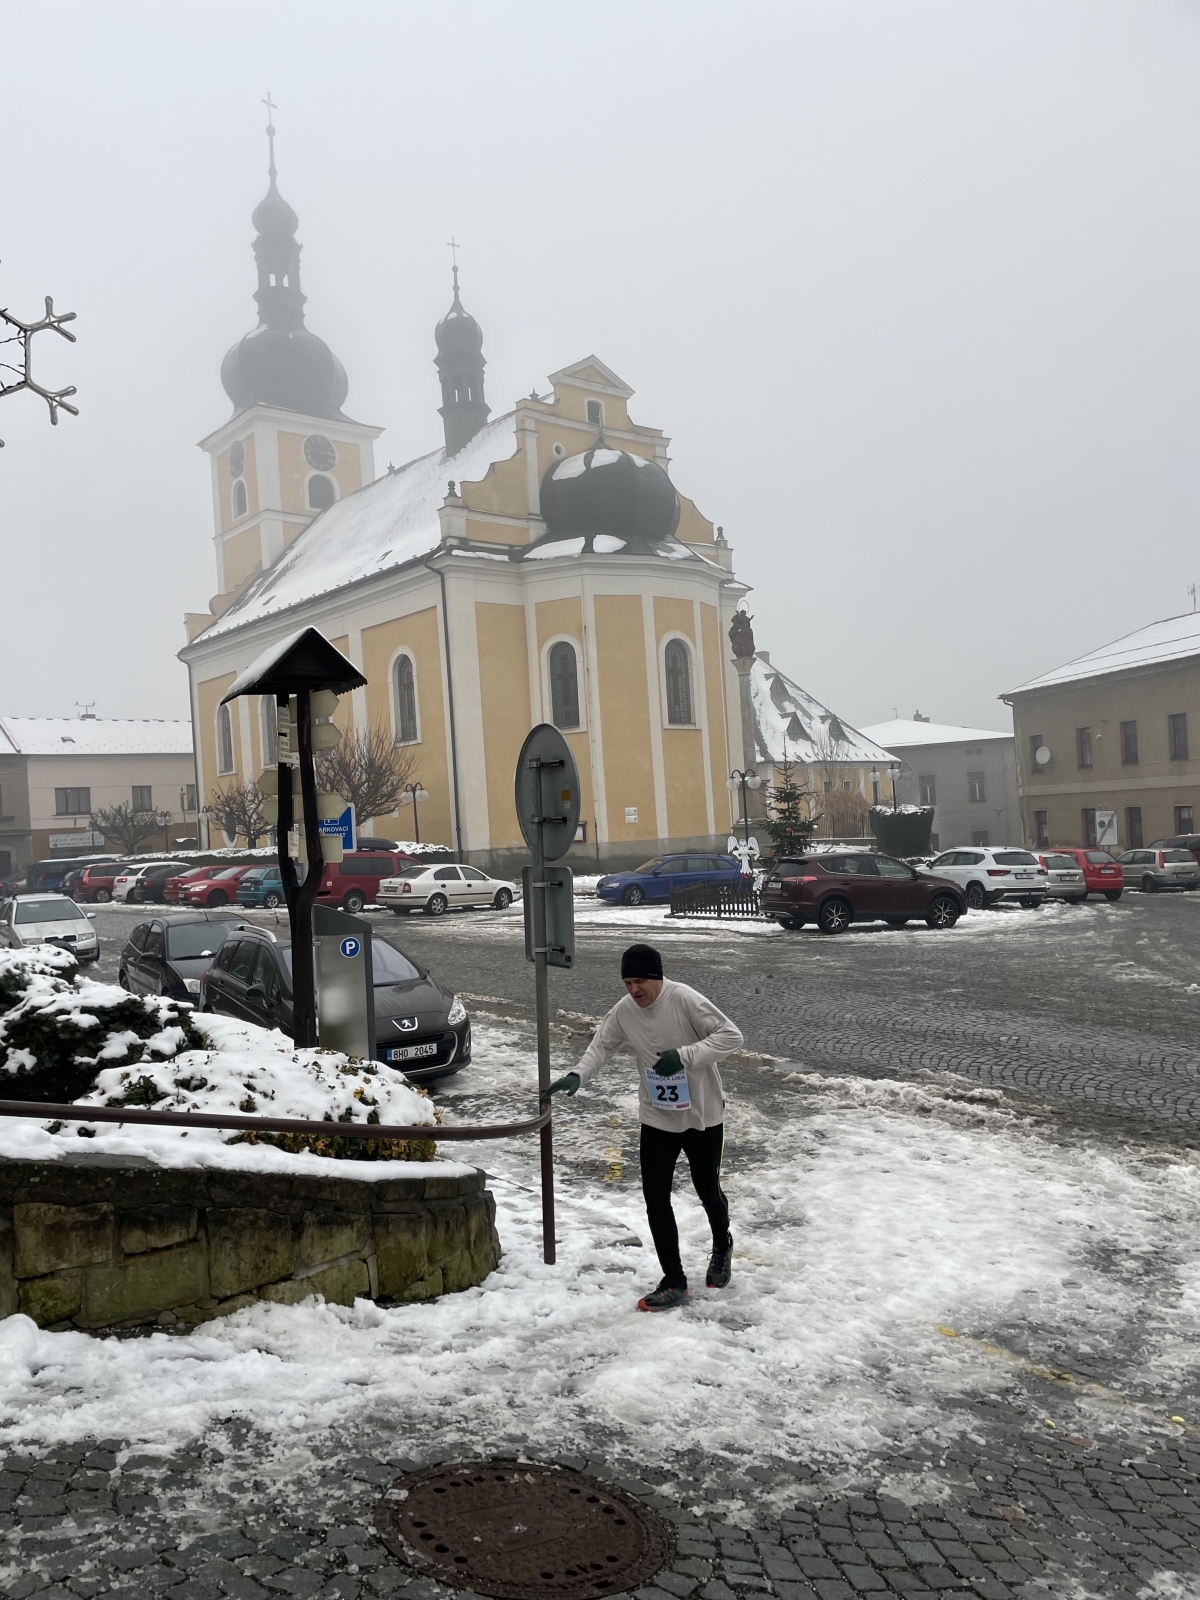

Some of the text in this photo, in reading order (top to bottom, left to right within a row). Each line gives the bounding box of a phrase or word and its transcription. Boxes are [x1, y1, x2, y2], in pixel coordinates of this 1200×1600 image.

[318, 825, 349, 833] ARKOVACÍ
[345, 941, 356, 955] P
[414, 1044, 434, 1057] 2045
[655, 1084, 680, 1103] 23
